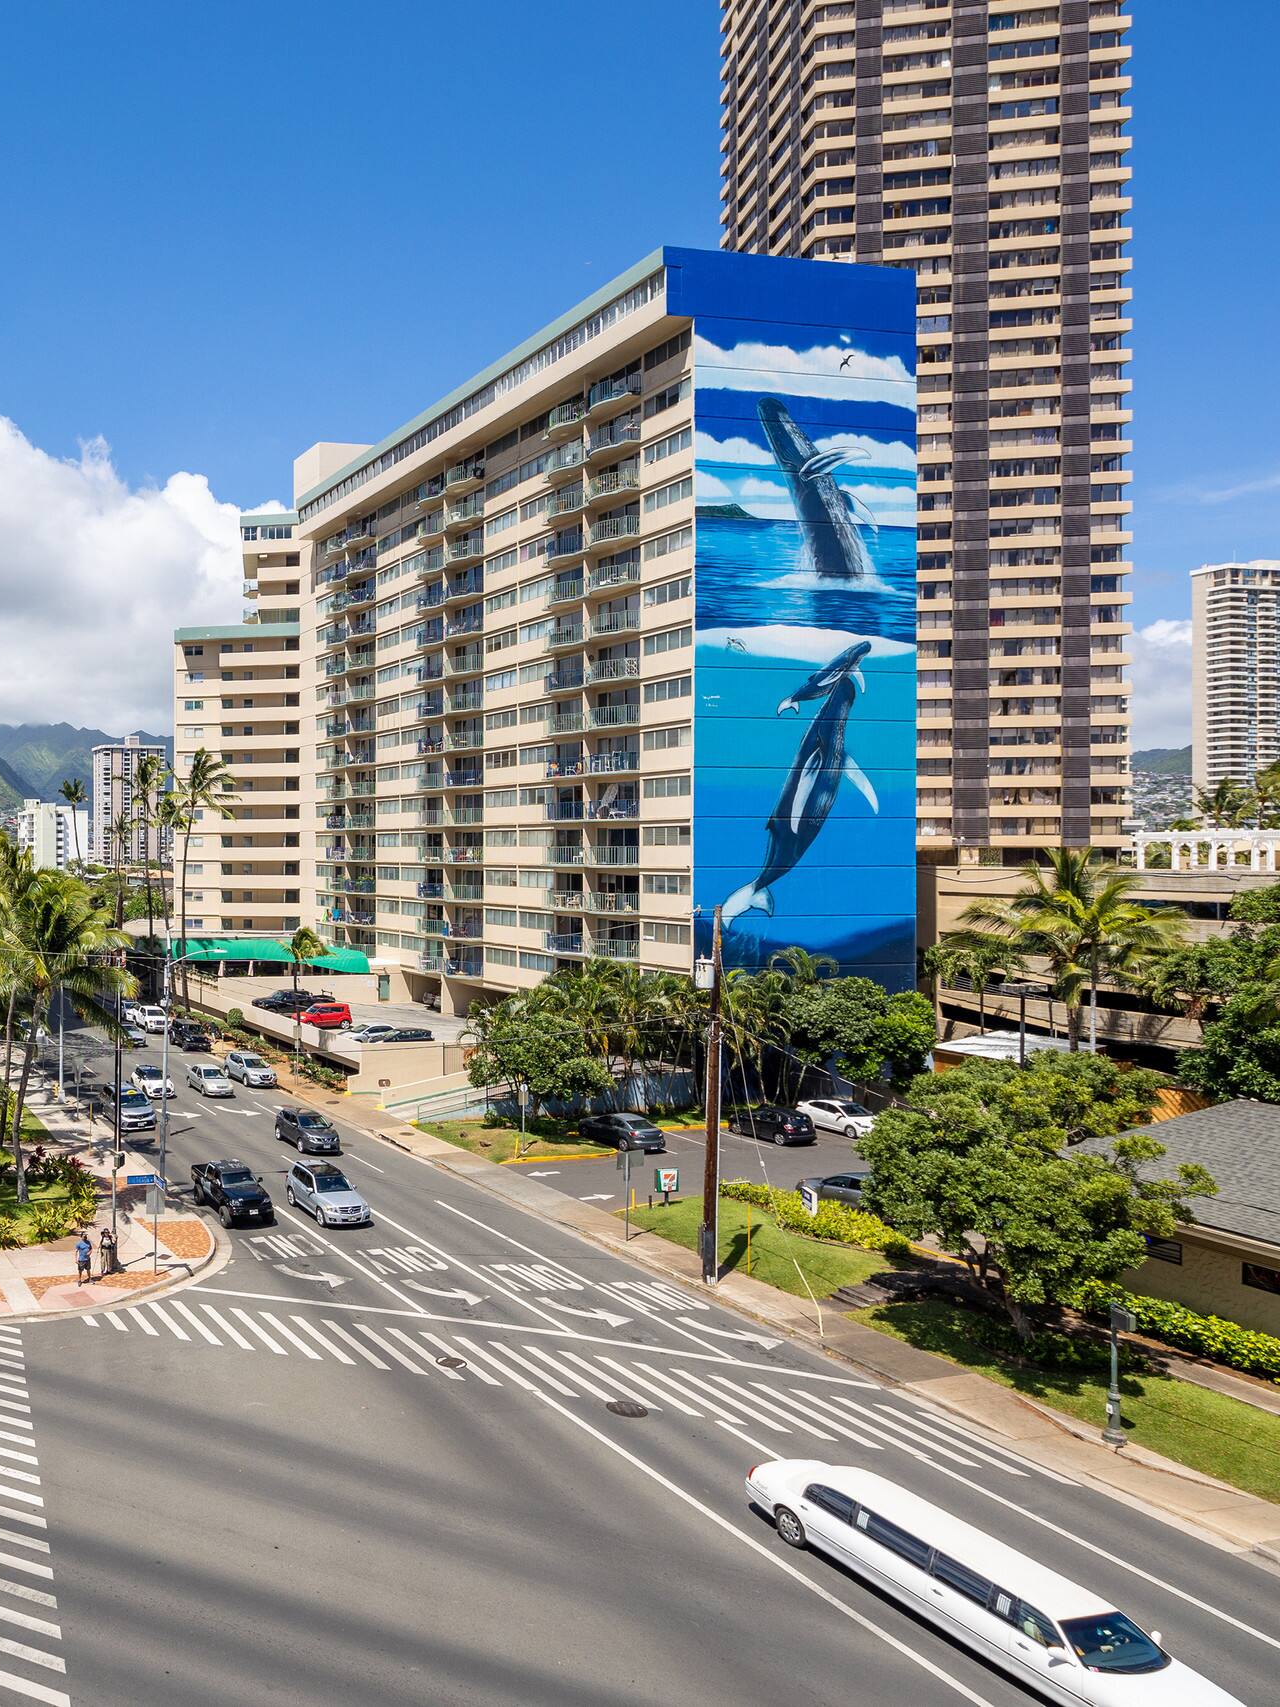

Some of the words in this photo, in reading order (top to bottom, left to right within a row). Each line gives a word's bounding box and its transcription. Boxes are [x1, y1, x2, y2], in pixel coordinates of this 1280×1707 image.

[238, 1234, 324, 1261] ONLY
[356, 1246, 448, 1274] ONLY
[479, 1264, 584, 1291] ONLY
[597, 1281, 710, 1311] ONLY
